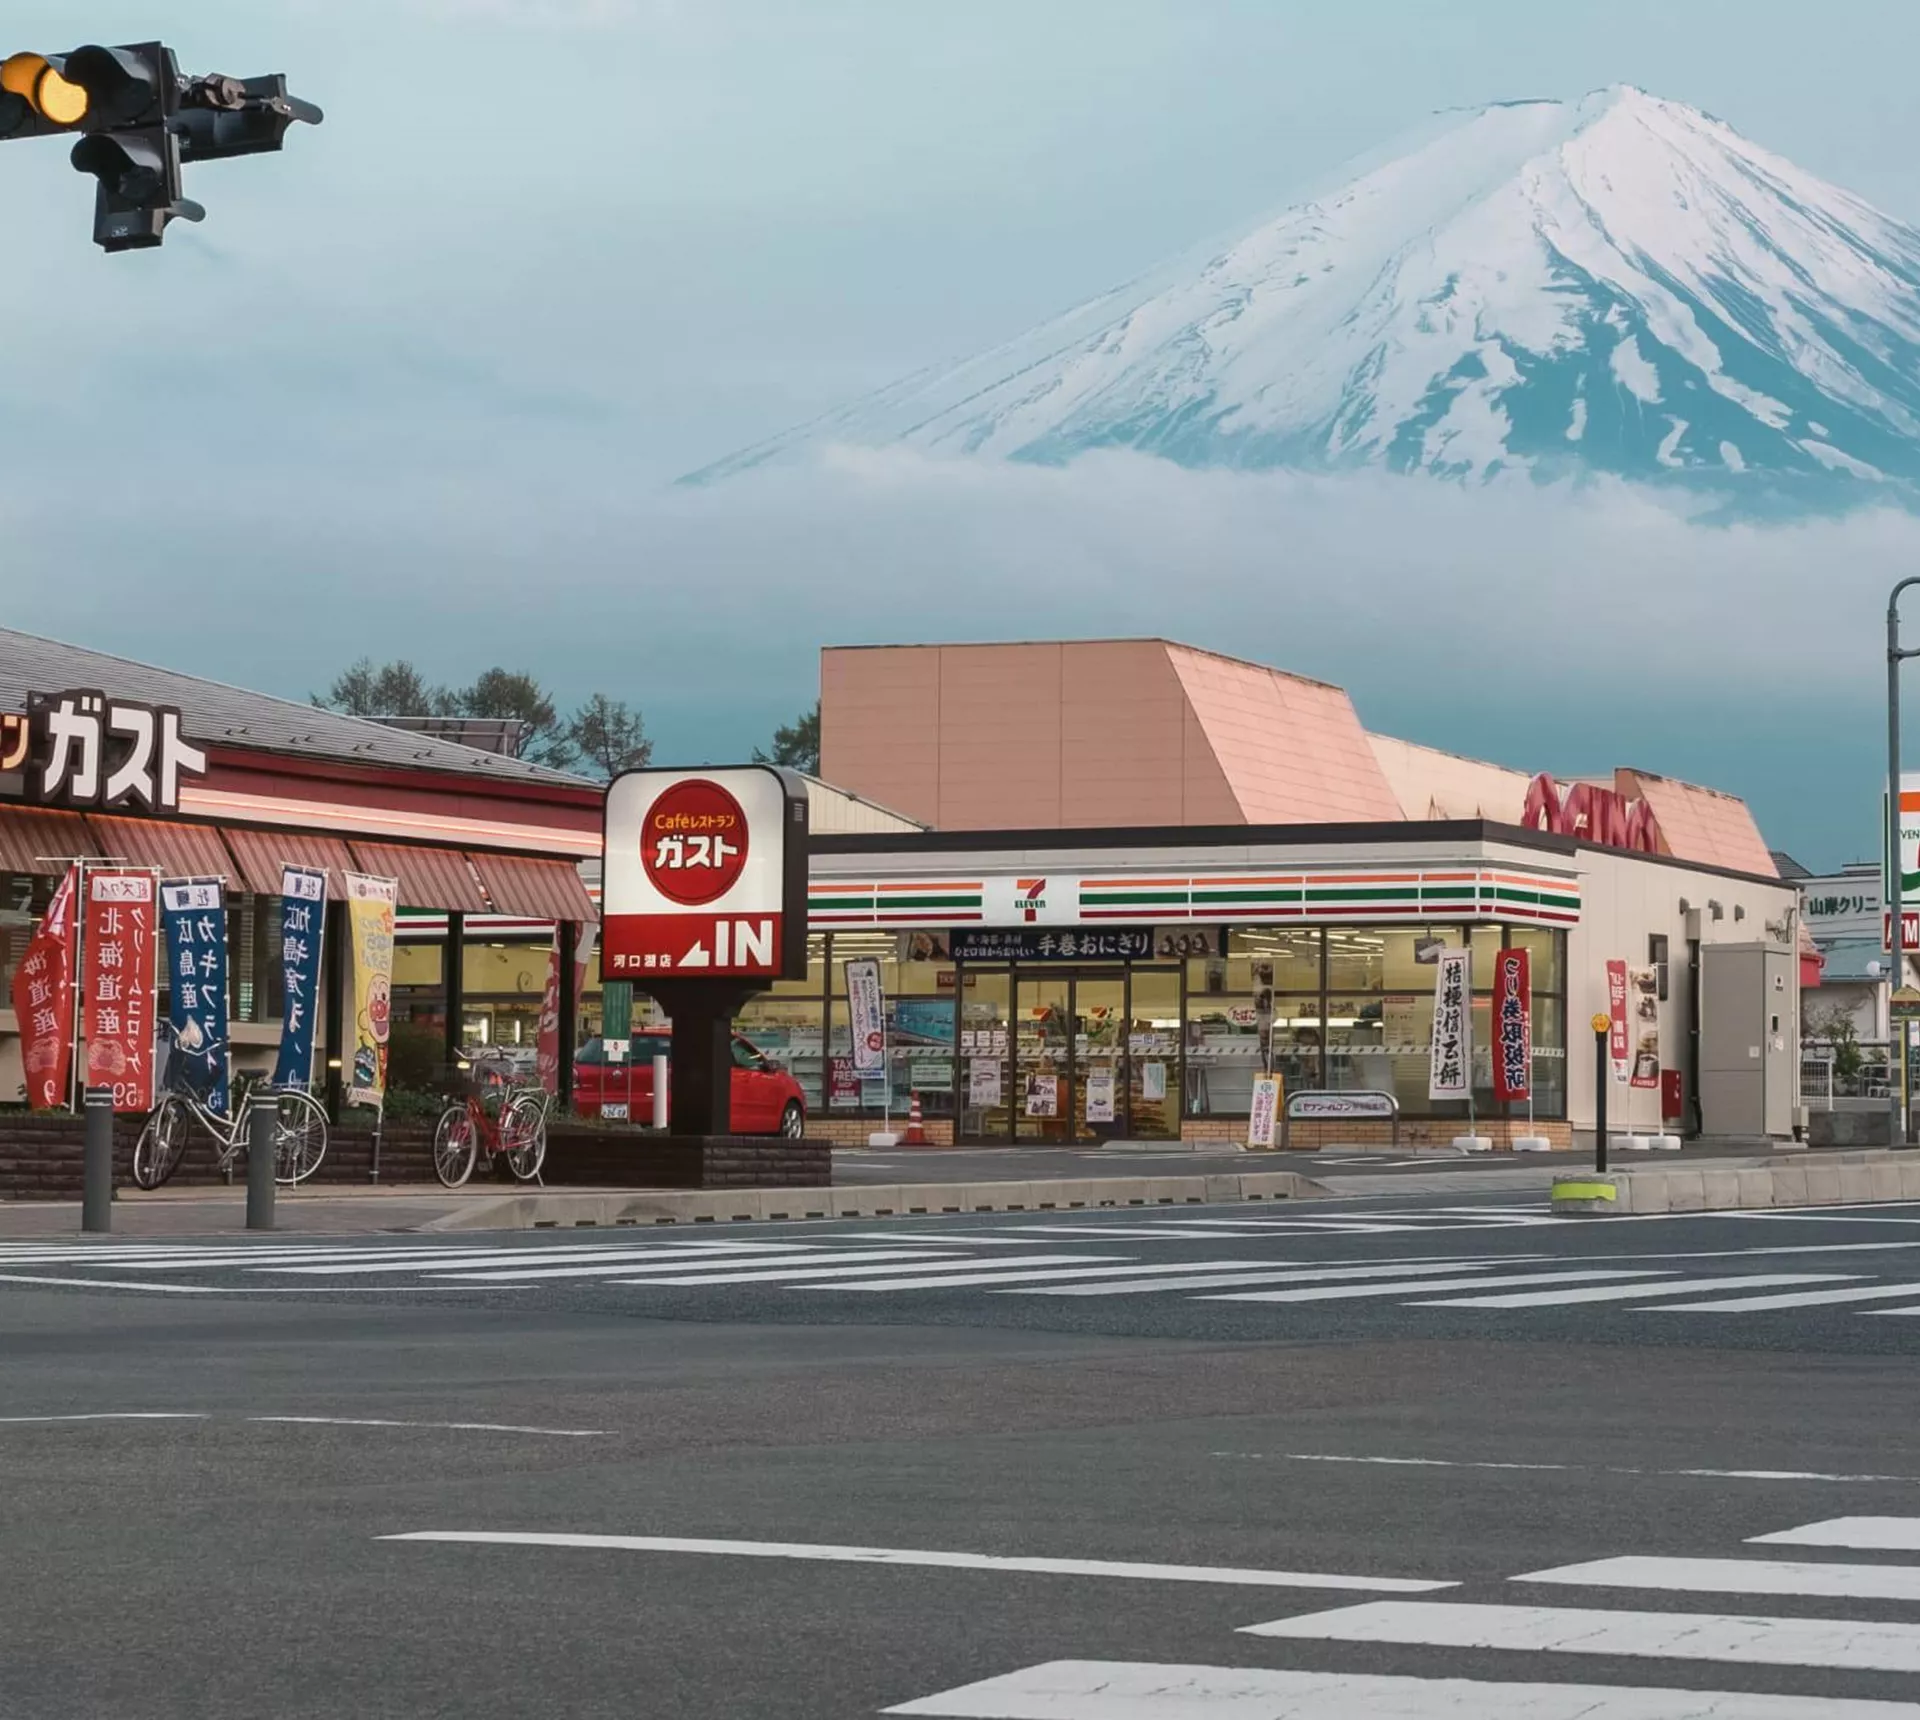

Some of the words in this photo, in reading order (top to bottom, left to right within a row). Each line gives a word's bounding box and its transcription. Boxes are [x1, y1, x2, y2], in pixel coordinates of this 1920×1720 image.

[44, 695, 206, 806] ガスト
[655, 834, 738, 868] ガスト
[715, 920, 773, 967] IN
[1038, 933, 1149, 956] 手巻おにぎり
[614, 954, 671, 968] 河口湖店
[1439, 962, 1463, 1087] 桔梗信玄餅
[833, 1060, 853, 1070] TAX
